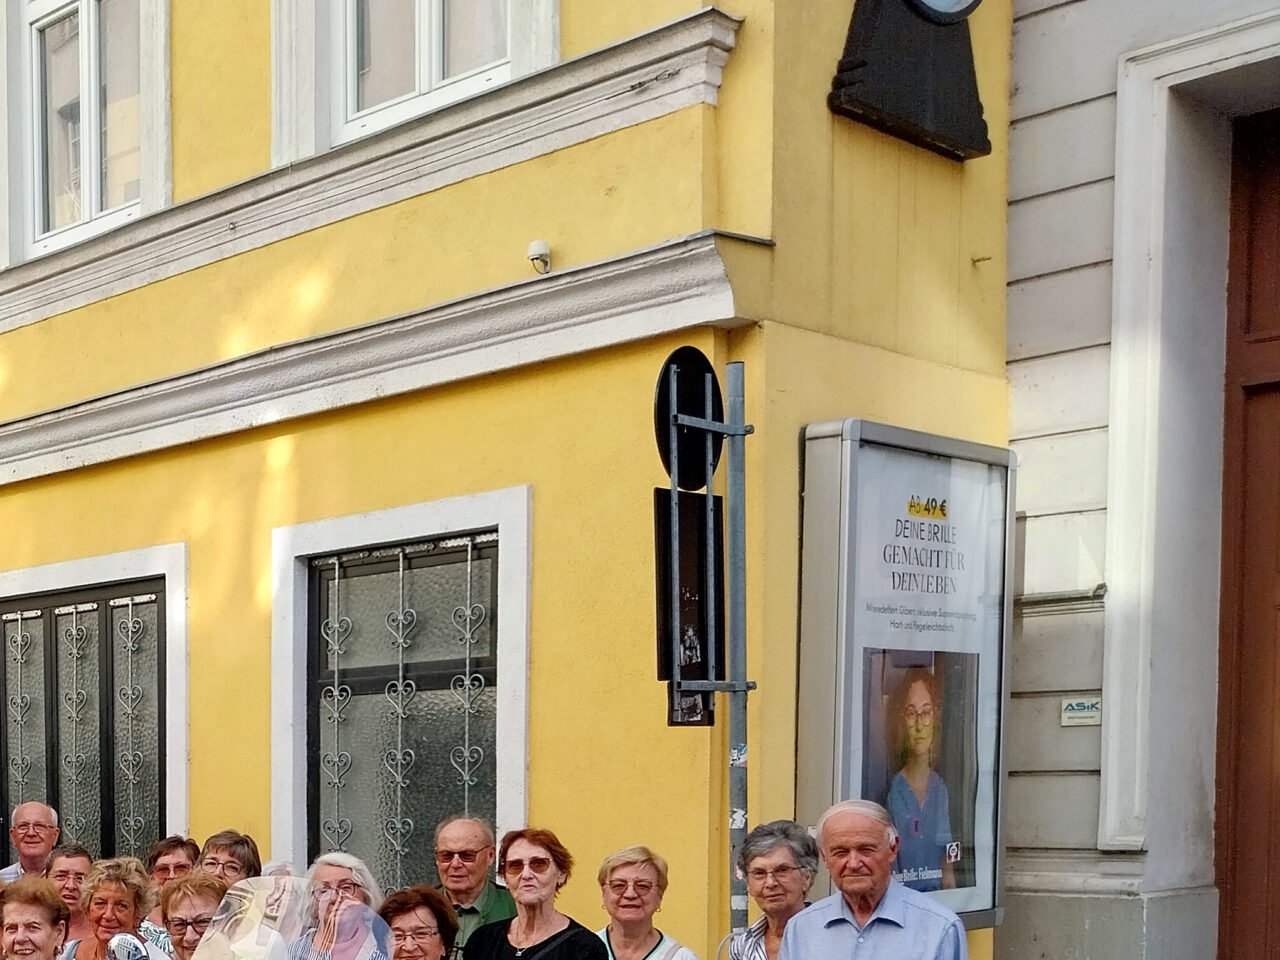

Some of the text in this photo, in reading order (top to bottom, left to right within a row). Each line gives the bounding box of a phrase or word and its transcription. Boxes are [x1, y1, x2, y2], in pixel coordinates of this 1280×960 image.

[924, 497, 937, 515] 49
[939, 499, 947, 517] €
[895, 519, 957, 545] DEINE BRILLE
[883, 543, 966, 571] GEMACHT FÜR
[891, 571, 957, 594] DEIN LEBEN
